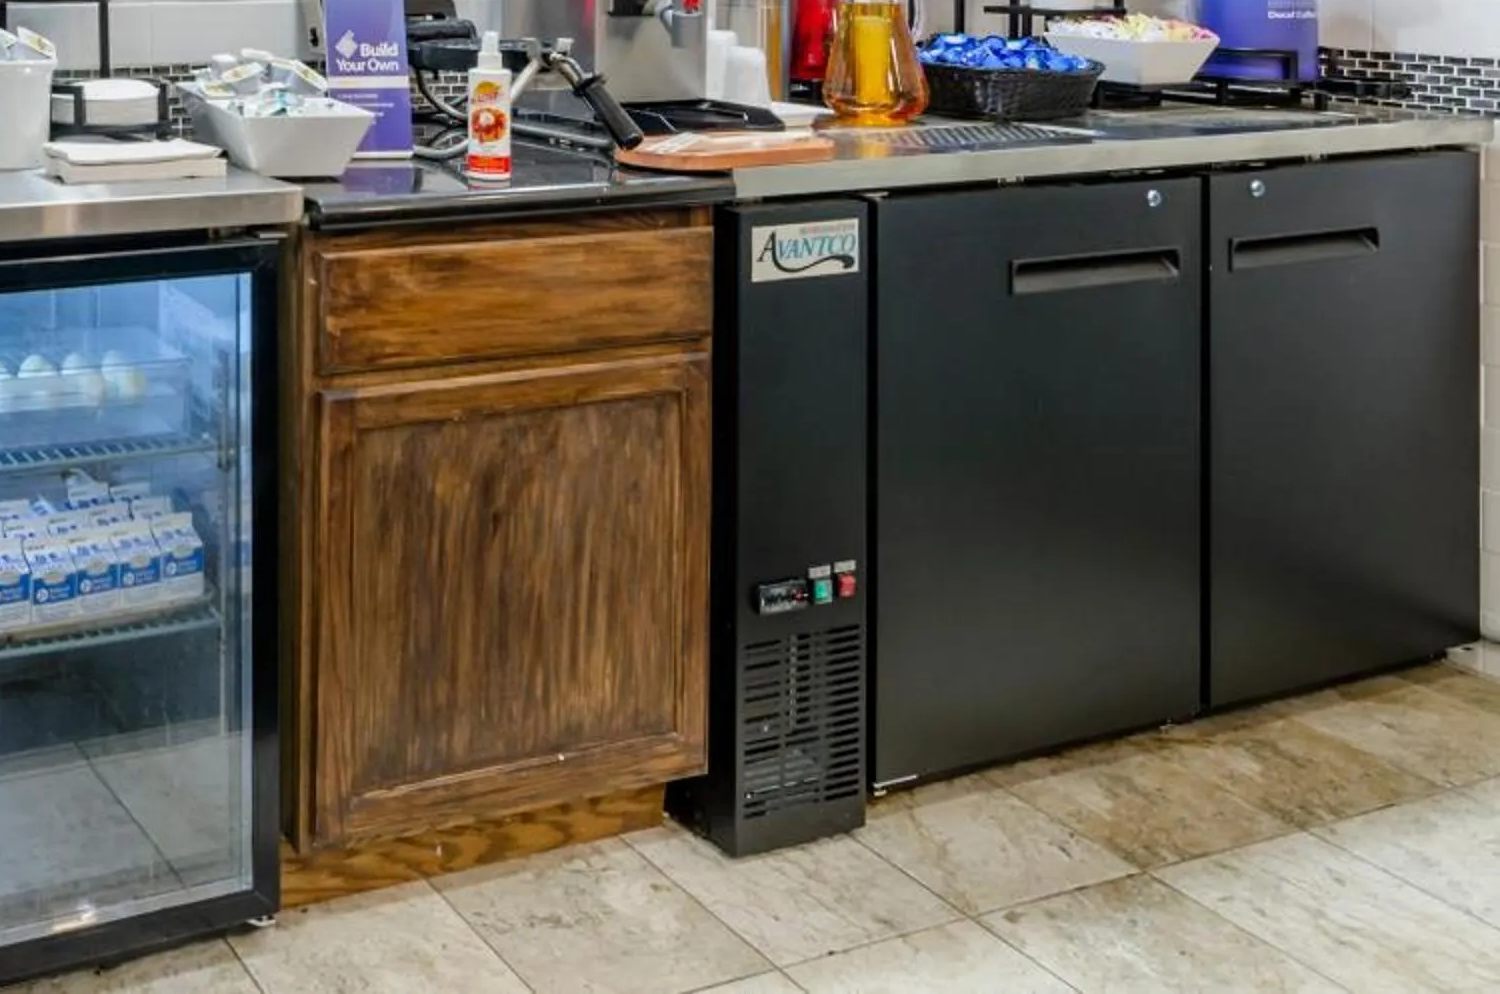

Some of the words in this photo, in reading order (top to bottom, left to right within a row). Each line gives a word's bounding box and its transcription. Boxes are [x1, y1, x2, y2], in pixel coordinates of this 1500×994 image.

[359, 42, 399, 57] Build
[336, 58, 366, 72] Your
[367, 58, 399, 72] Own
[756, 231, 856, 272] AVANTCO
